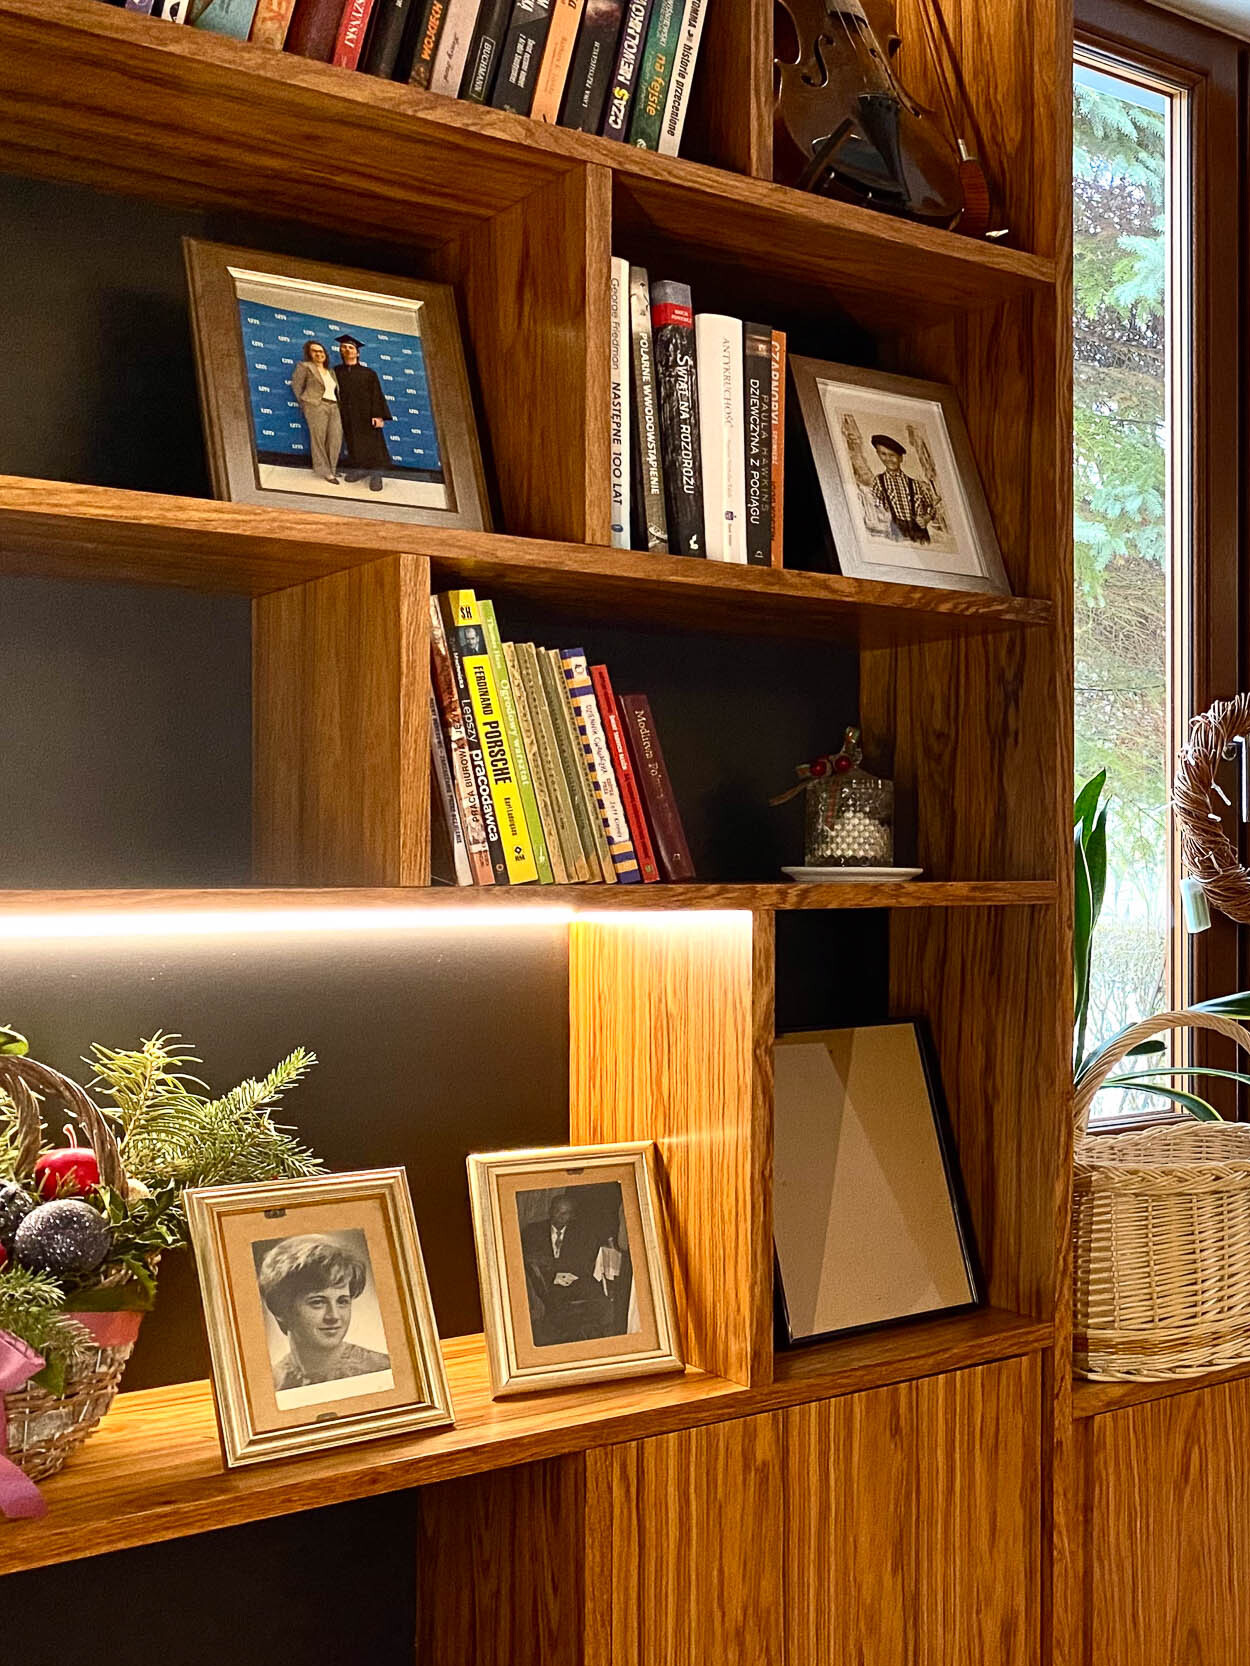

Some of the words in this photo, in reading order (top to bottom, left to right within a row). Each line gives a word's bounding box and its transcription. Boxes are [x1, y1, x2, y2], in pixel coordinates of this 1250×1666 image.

[421, 1, 443, 60] WOJCIECH
[474, 43, 491, 93] BUCHMANN
[654, 53, 666, 73] na
[679, 44, 693, 80] historie
[608, 86, 629, 129] CZAS
[646, 76, 665, 116] fejsie
[667, 79, 685, 137] przecenione
[611, 321, 620, 370] Friedman
[640, 332, 651, 382] POLARNE
[612, 381, 621, 445] NASTĘPNE
[679, 399, 690, 420] NA
[750, 379, 759, 454] DZIEWCZYNA
[761, 394, 769, 438] PAULA
[612, 452, 623, 478] 100
[680, 424, 695, 494] ROZDROŻU
[750, 458, 759, 467] Z
[761, 448, 769, 511] HAWKINS
[613, 483, 622, 505] LAT
[747, 471, 760, 524] POCIĄGU
[473, 666, 494, 716] FERDINAND
[482, 720, 512, 785] PORSCHE
[635, 709, 653, 759] Modlitwa
[460, 743, 474, 788] BIUROWA
[461, 699, 477, 743] Lepszy
[471, 749, 498, 842] pracodawca
[513, 737, 529, 785] warsztat
[468, 790, 480, 823] PRACA
